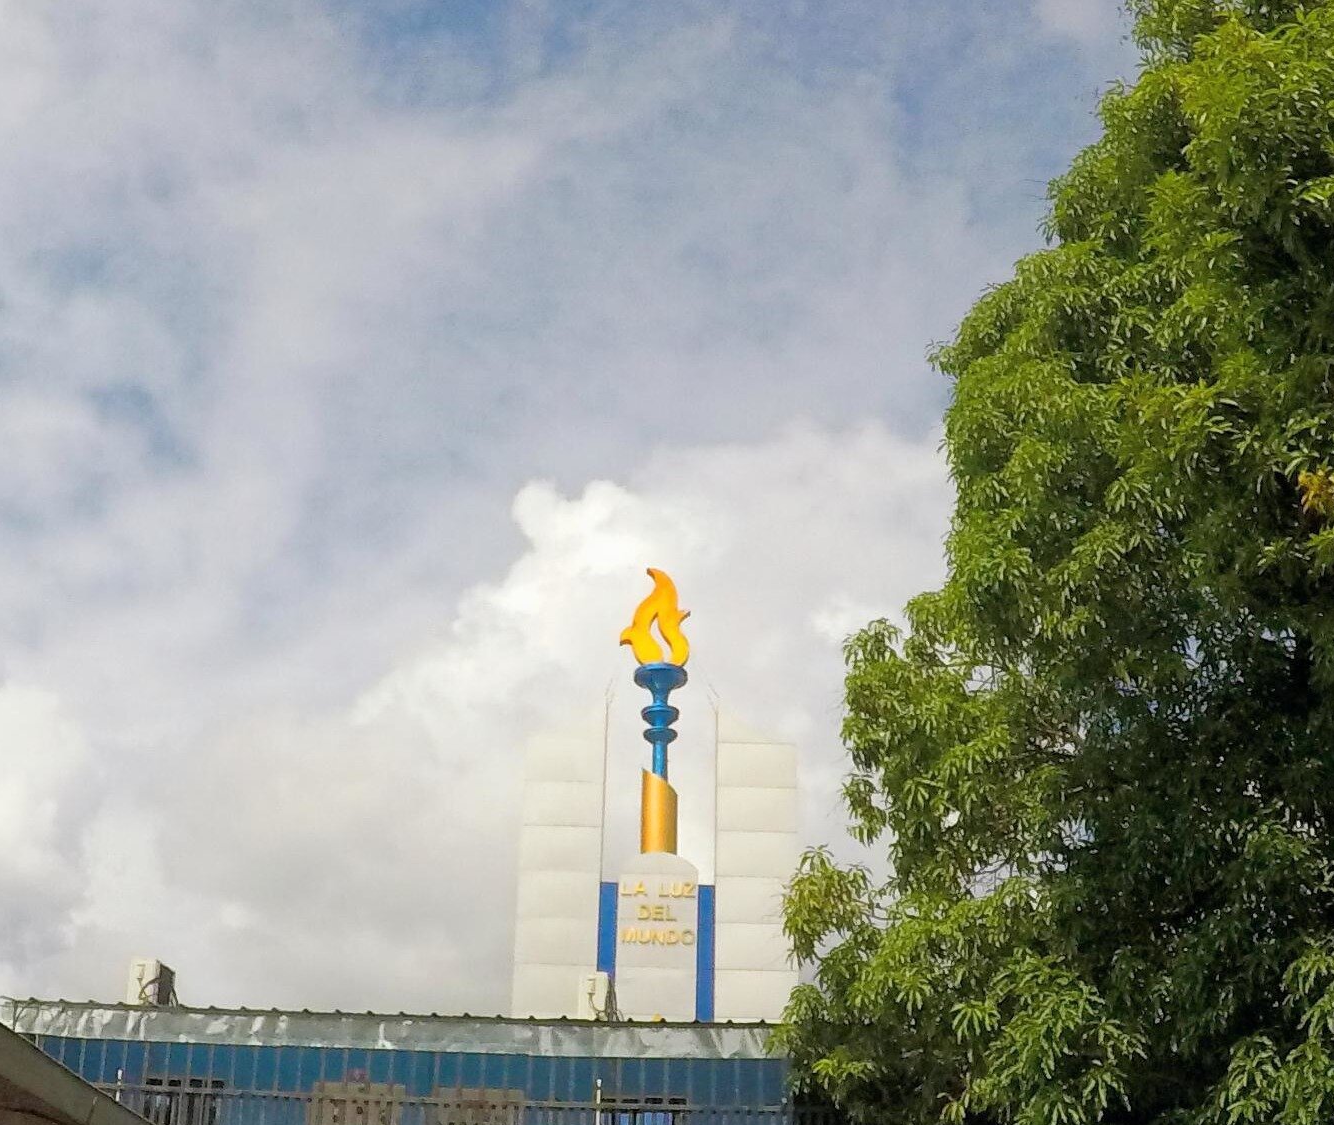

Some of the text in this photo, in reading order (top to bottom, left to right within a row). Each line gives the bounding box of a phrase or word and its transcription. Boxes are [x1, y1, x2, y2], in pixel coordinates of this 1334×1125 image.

[621, 880, 696, 898] LA LUZ
[638, 904, 677, 921] DEL
[622, 927, 695, 946] MUNDO
